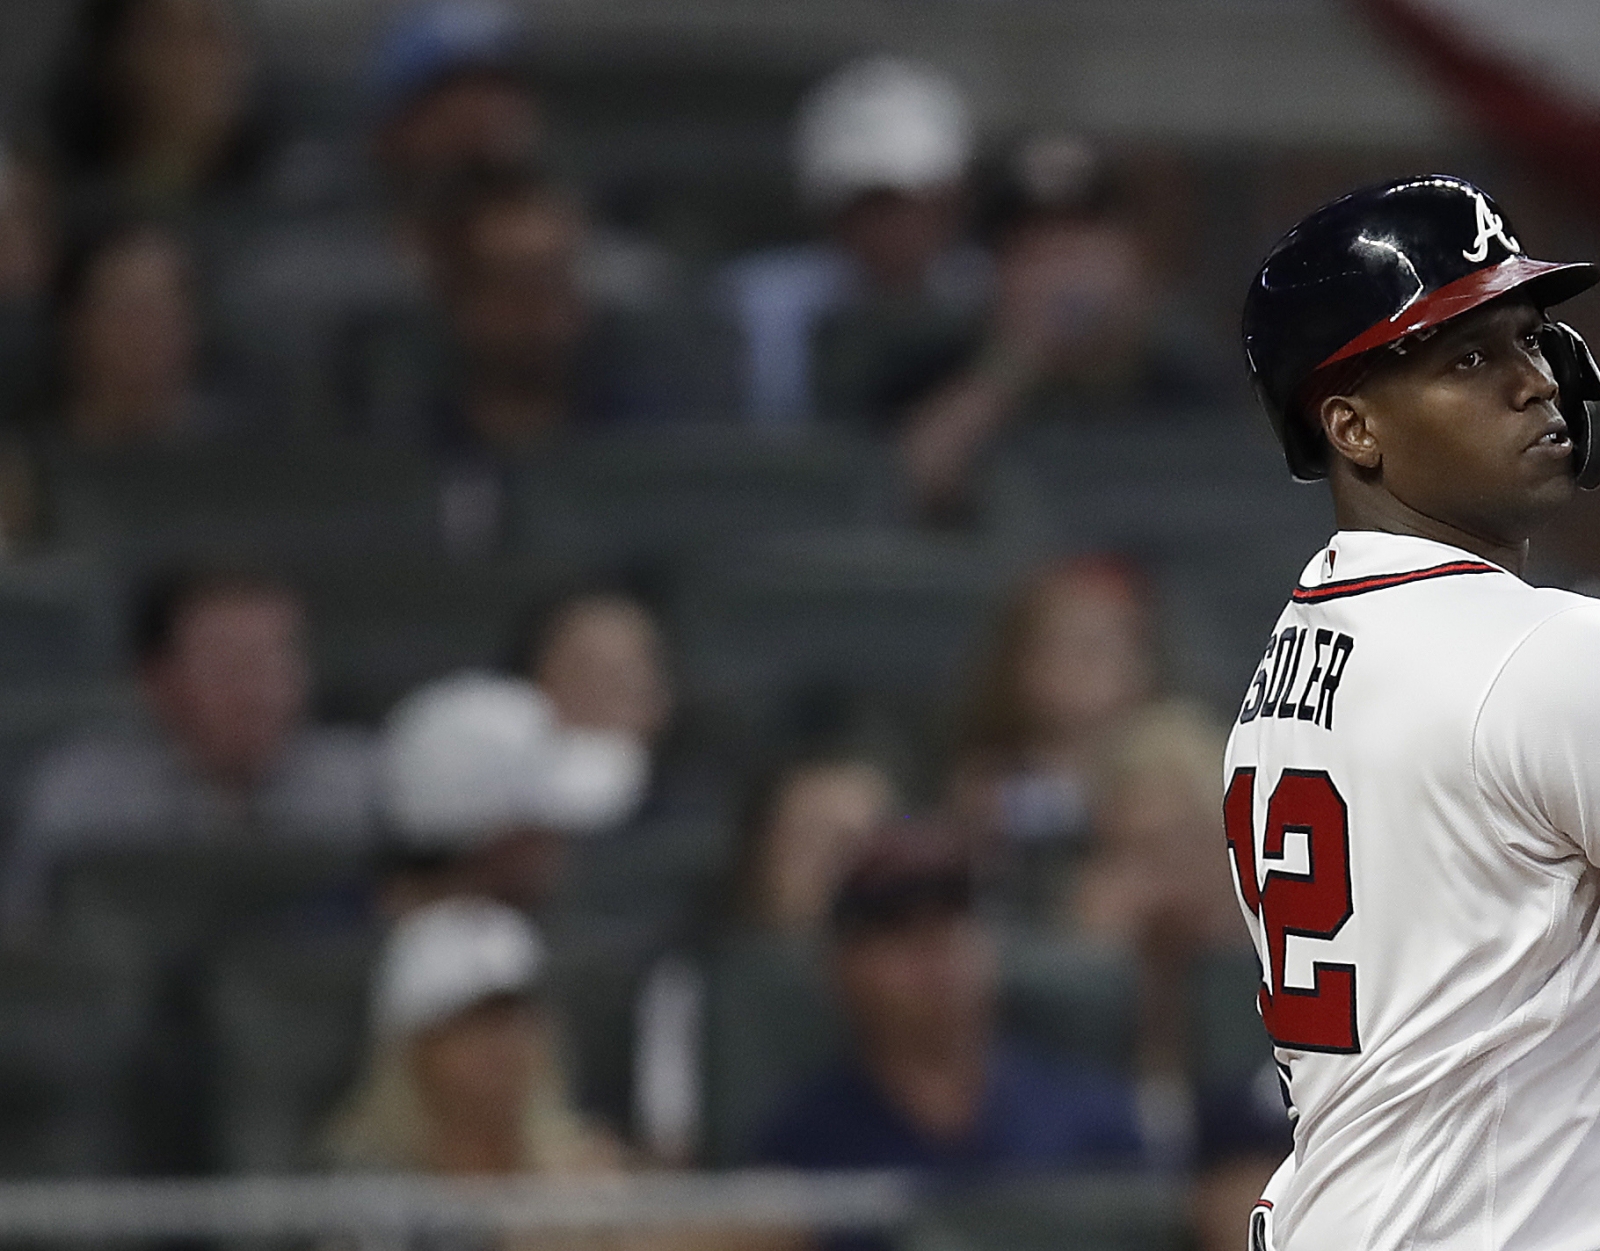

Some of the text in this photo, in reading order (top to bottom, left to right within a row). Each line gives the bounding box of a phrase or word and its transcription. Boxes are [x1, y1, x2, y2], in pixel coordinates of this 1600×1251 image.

[1462, 192, 1520, 263] A
[1240, 626, 1354, 732] SOLER
[1223, 766, 1361, 1054] 12
